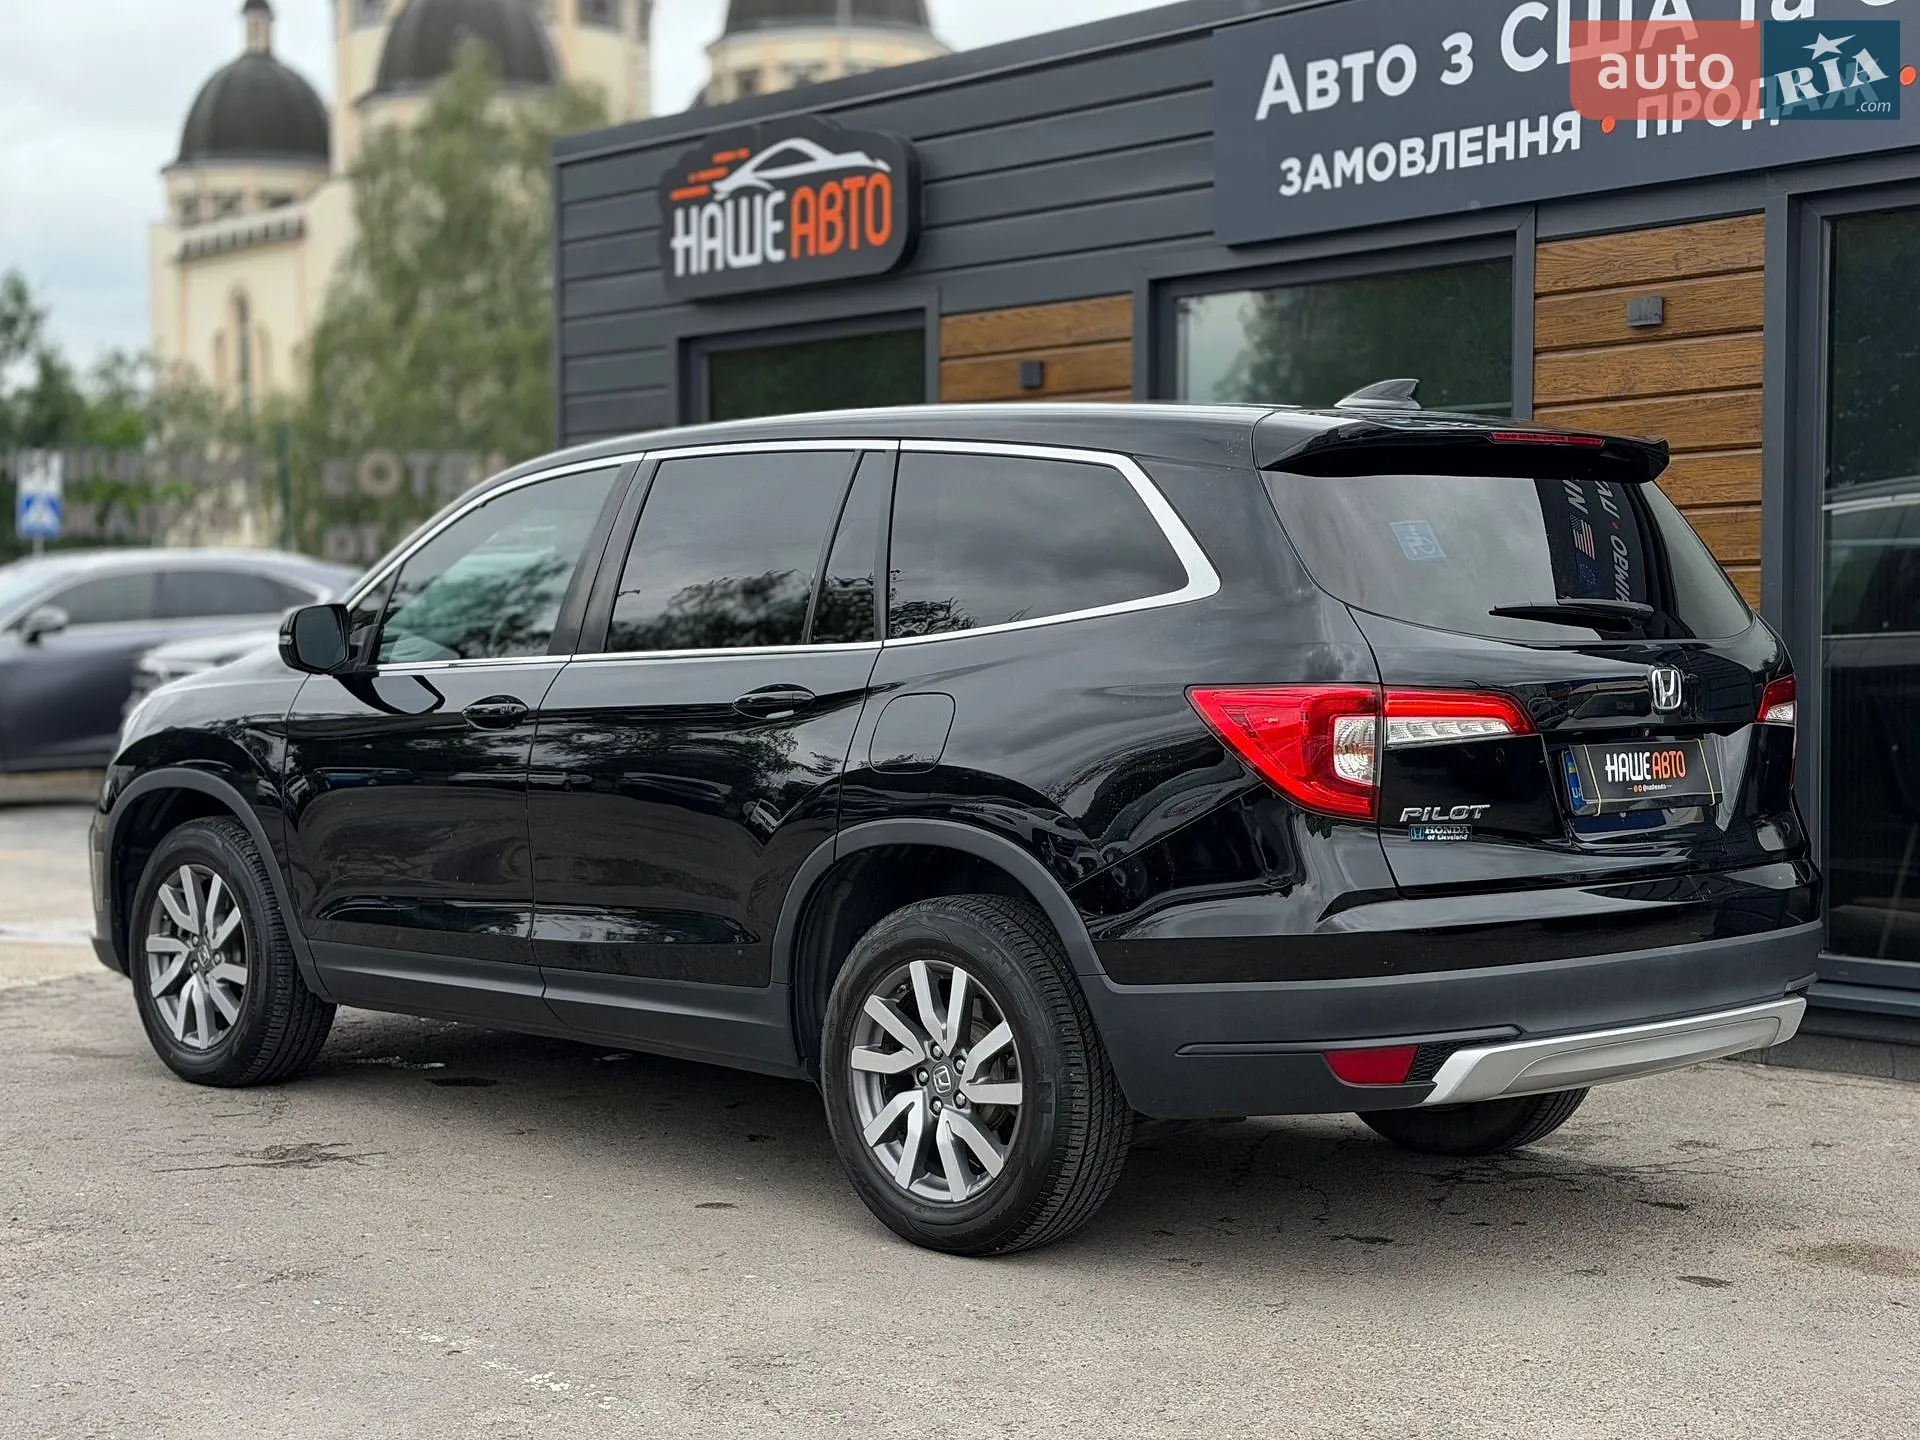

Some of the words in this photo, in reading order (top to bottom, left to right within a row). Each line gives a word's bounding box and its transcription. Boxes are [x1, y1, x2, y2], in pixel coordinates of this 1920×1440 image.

[1279, 110, 1581, 197] ЗАМОВЛЕННЯ
[1399, 804, 1491, 822] PILOT
[1424, 826, 1470, 834] HONDA
